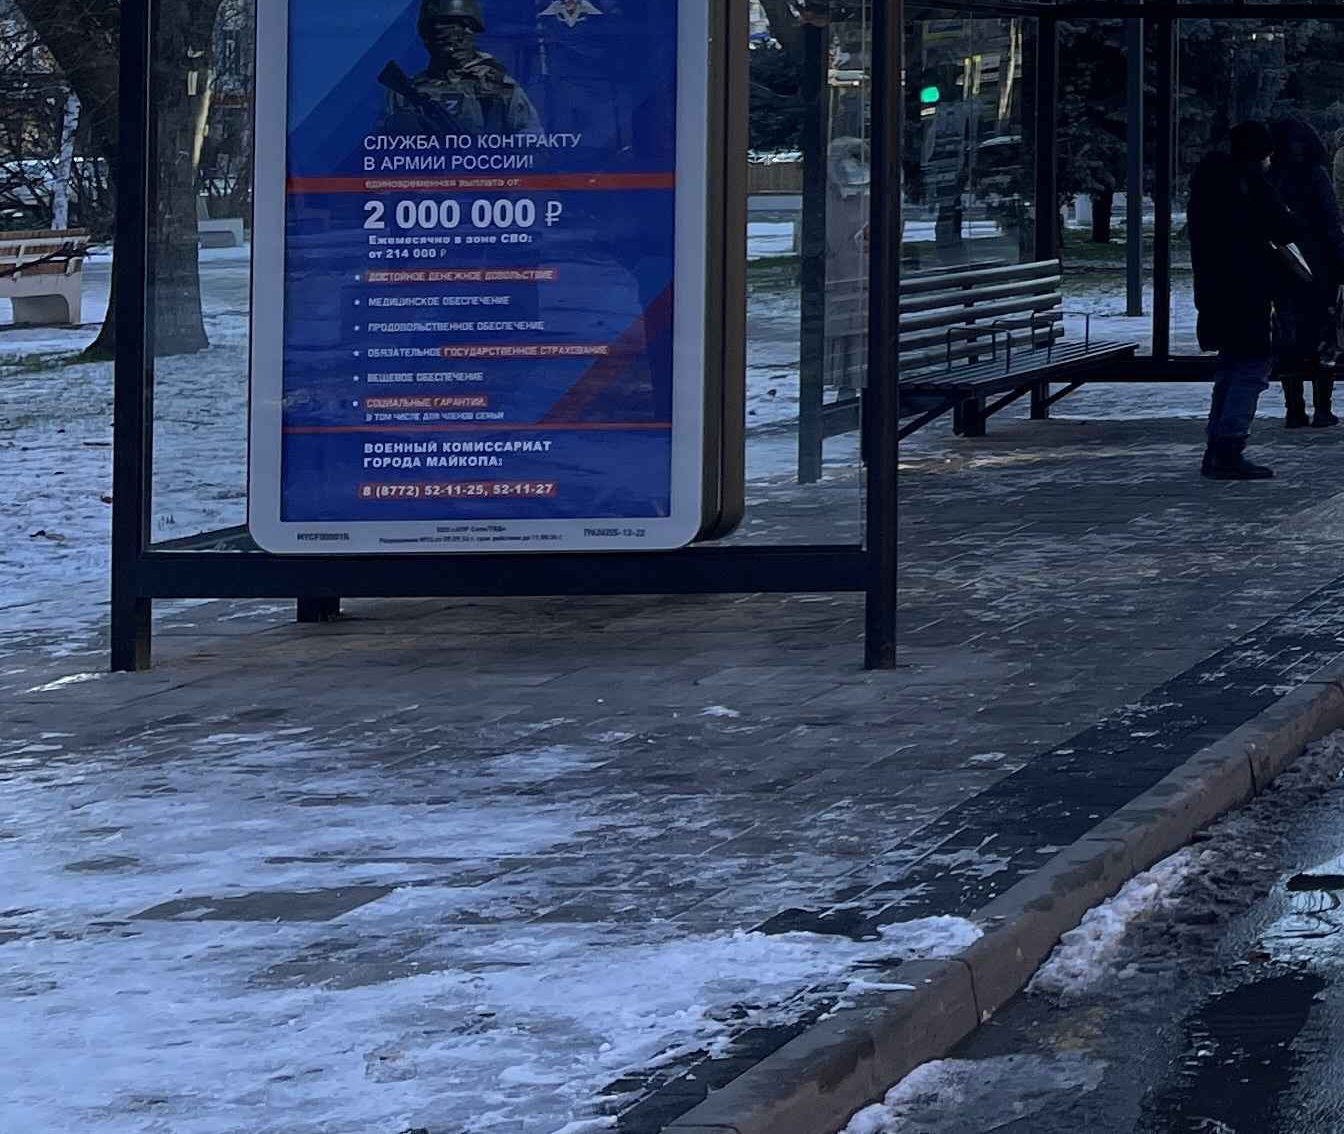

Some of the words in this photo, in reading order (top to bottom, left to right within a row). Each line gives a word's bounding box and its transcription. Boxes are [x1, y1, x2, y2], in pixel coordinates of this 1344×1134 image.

[363, 135, 440, 150] СЛУЖБА
[445, 134, 472, 149] ПО
[477, 133, 582, 149] КОНТРАКТУ
[363, 156, 375, 171] В
[381, 155, 446, 170] АРМИИ
[452, 154, 534, 169] РОССИИ!
[363, 200, 385, 229] 2
[395, 199, 461, 228] 000
[471, 198, 535, 228] 000
[369, 235, 450, 245] Ежемесячно
[369, 251, 382, 259] от
[385, 249, 409, 259] 214
[413, 249, 436, 258] 000
[364, 441, 438, 453] ВОЕННЫЙ
[443, 440, 552, 452] КОМИССАРИАТ
[363, 457, 424, 468] ГОРОДА
[426, 455, 503, 467] МАЙКОПА:
[363, 486, 372, 496] 8
[376, 486, 420, 498] (8772)
[493, 483, 553, 495] 52-11-27
